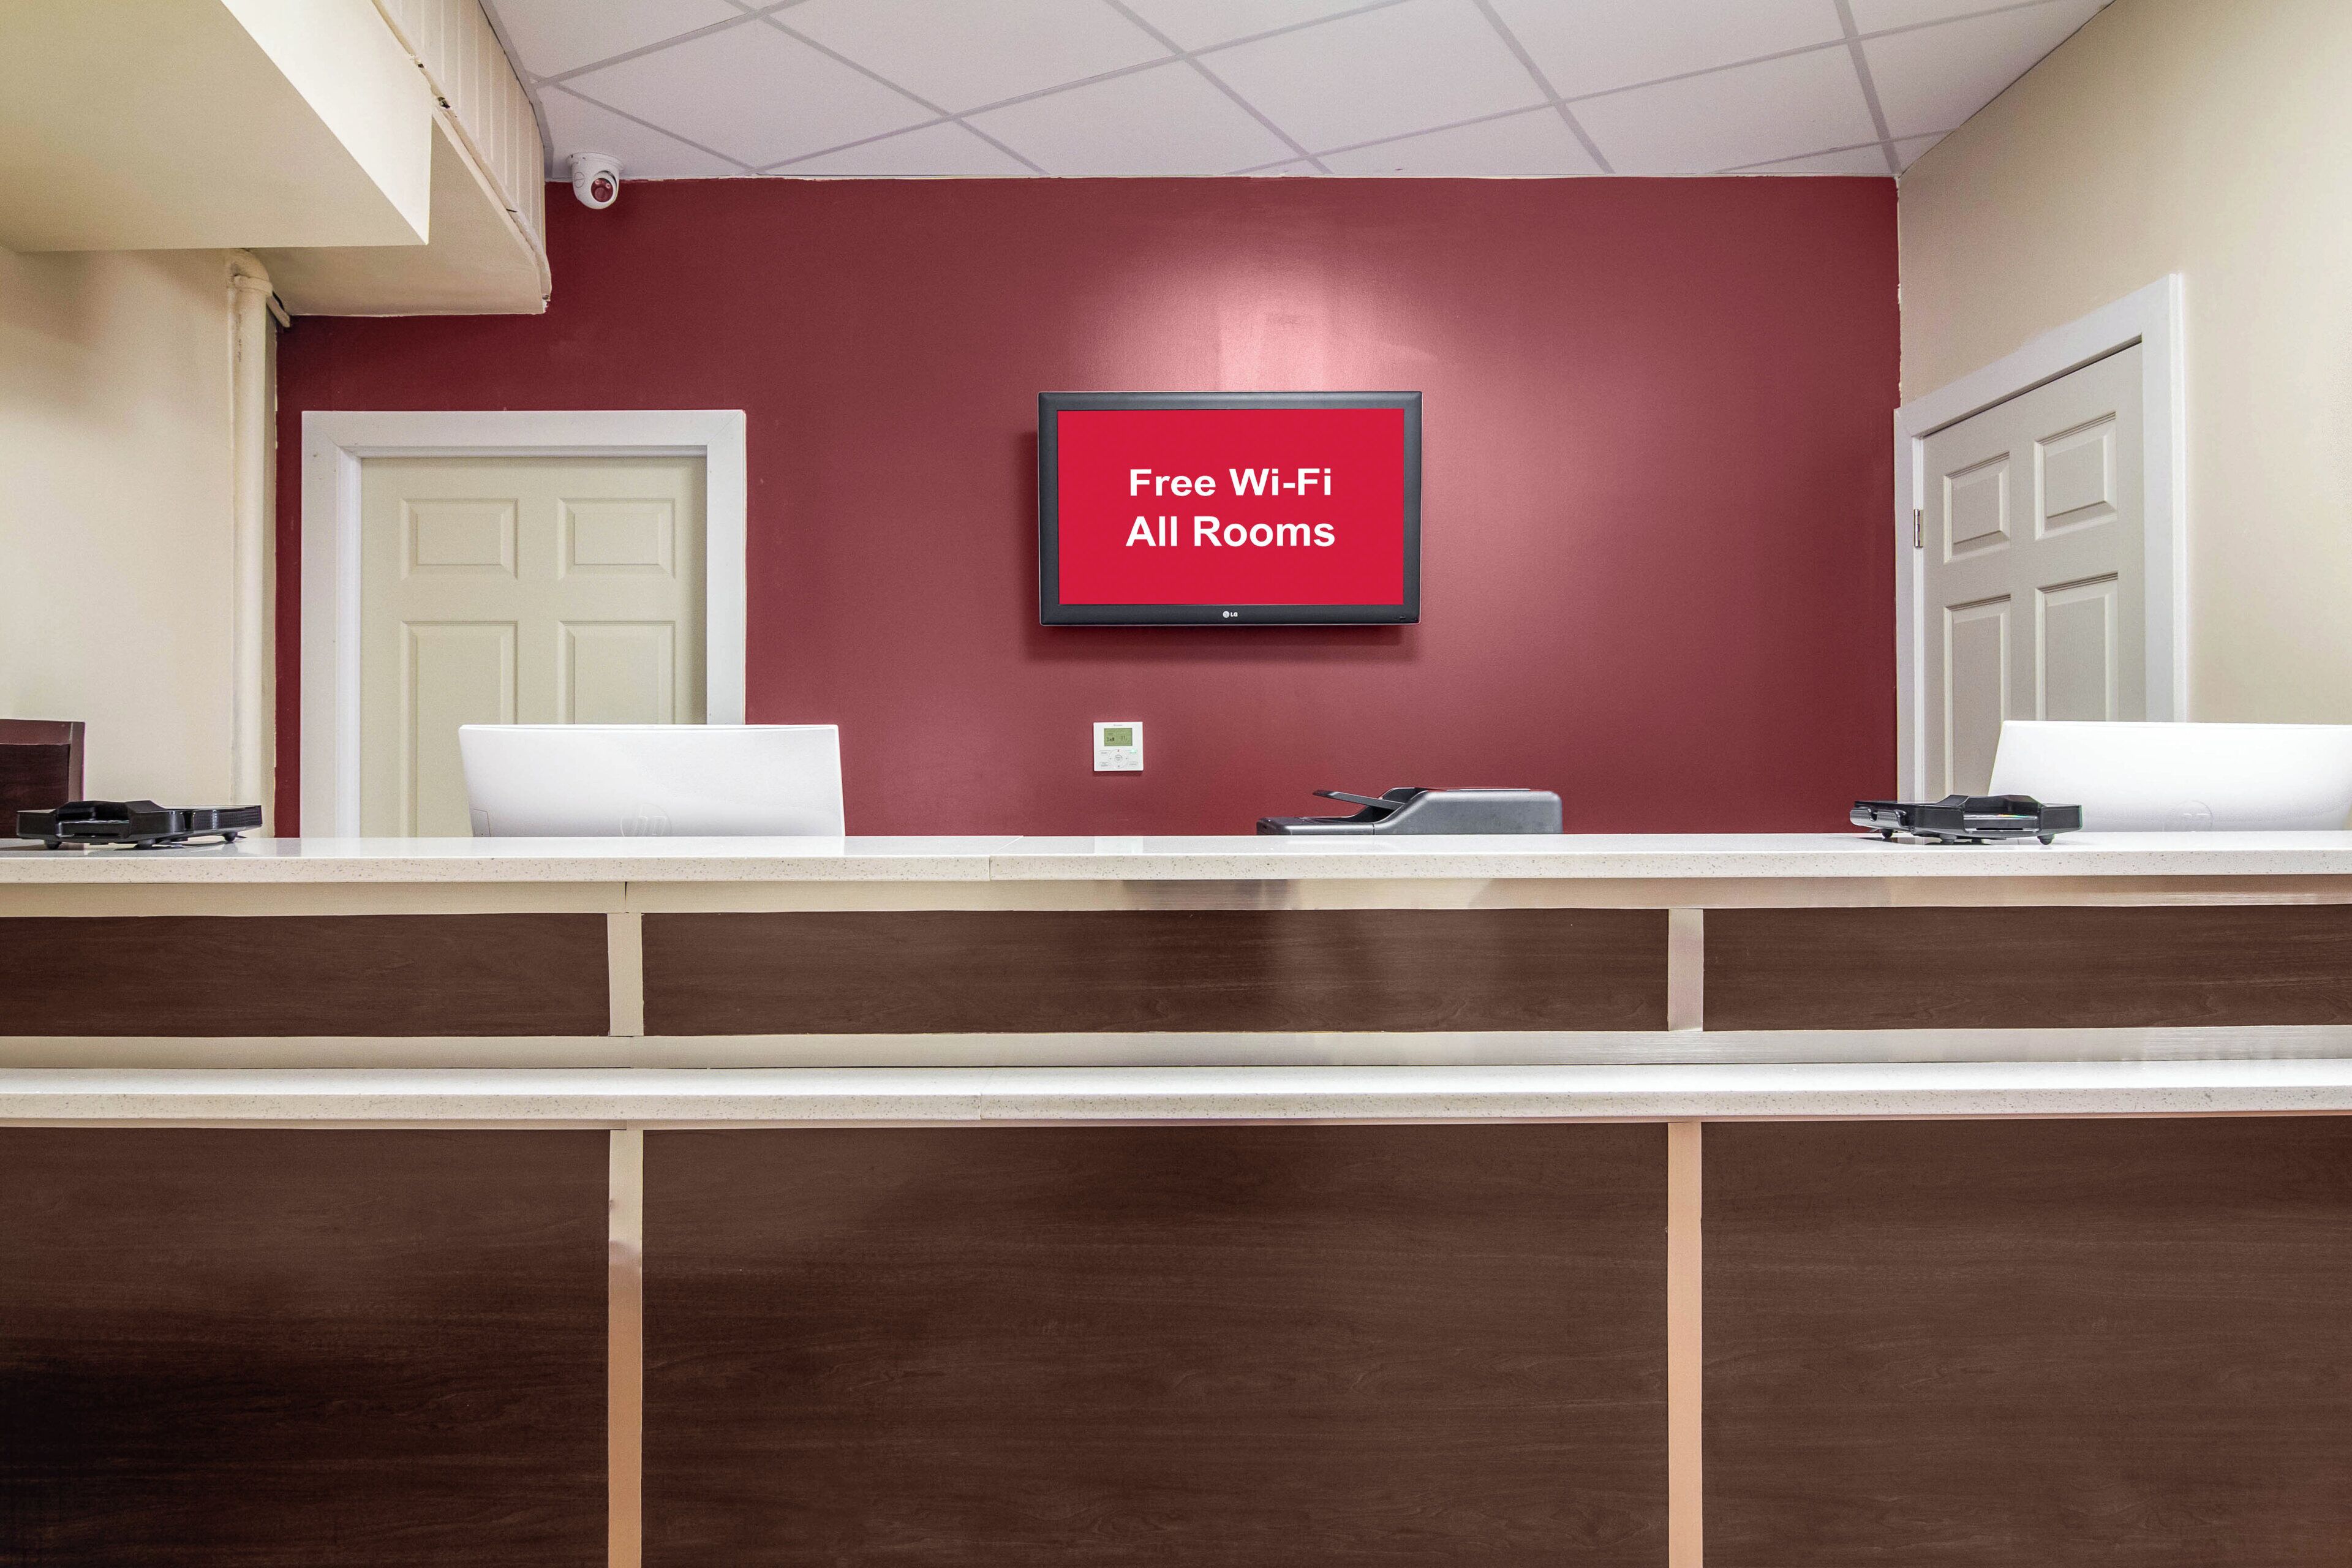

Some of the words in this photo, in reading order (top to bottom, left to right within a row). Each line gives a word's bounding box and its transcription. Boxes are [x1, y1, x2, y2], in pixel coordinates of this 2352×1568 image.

[1130, 469, 1216, 496] Free
[1229, 468, 1330, 496] Wi-Fi
[1126, 516, 1177, 546] All
[1194, 516, 1335, 546] Rooms
